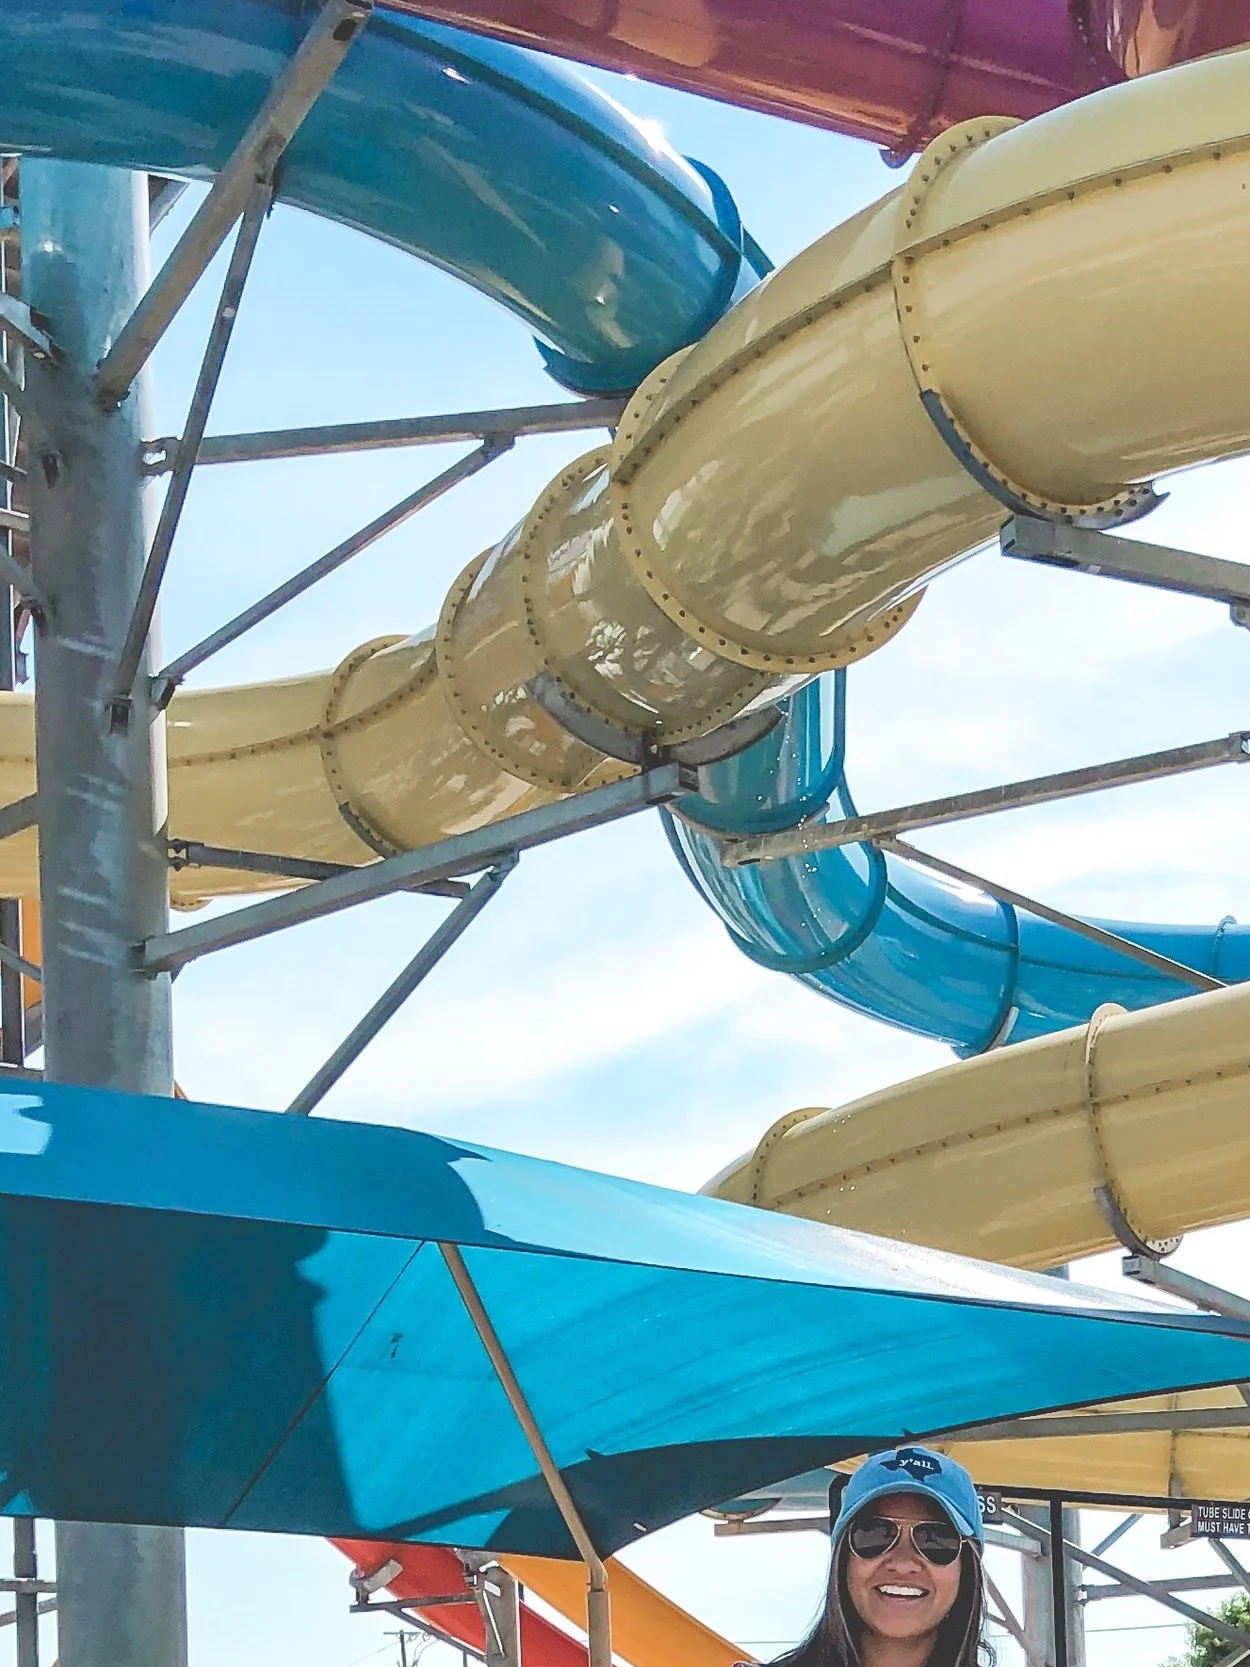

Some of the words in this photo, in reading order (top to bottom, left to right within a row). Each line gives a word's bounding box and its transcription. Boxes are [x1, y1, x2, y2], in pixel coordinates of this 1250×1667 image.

[1198, 1506, 1220, 1518] TUBE
[1222, 1508, 1246, 1520] SLIDE
[1197, 1521, 1220, 1533] MUST
[1222, 1522, 1245, 1534] HAVE
